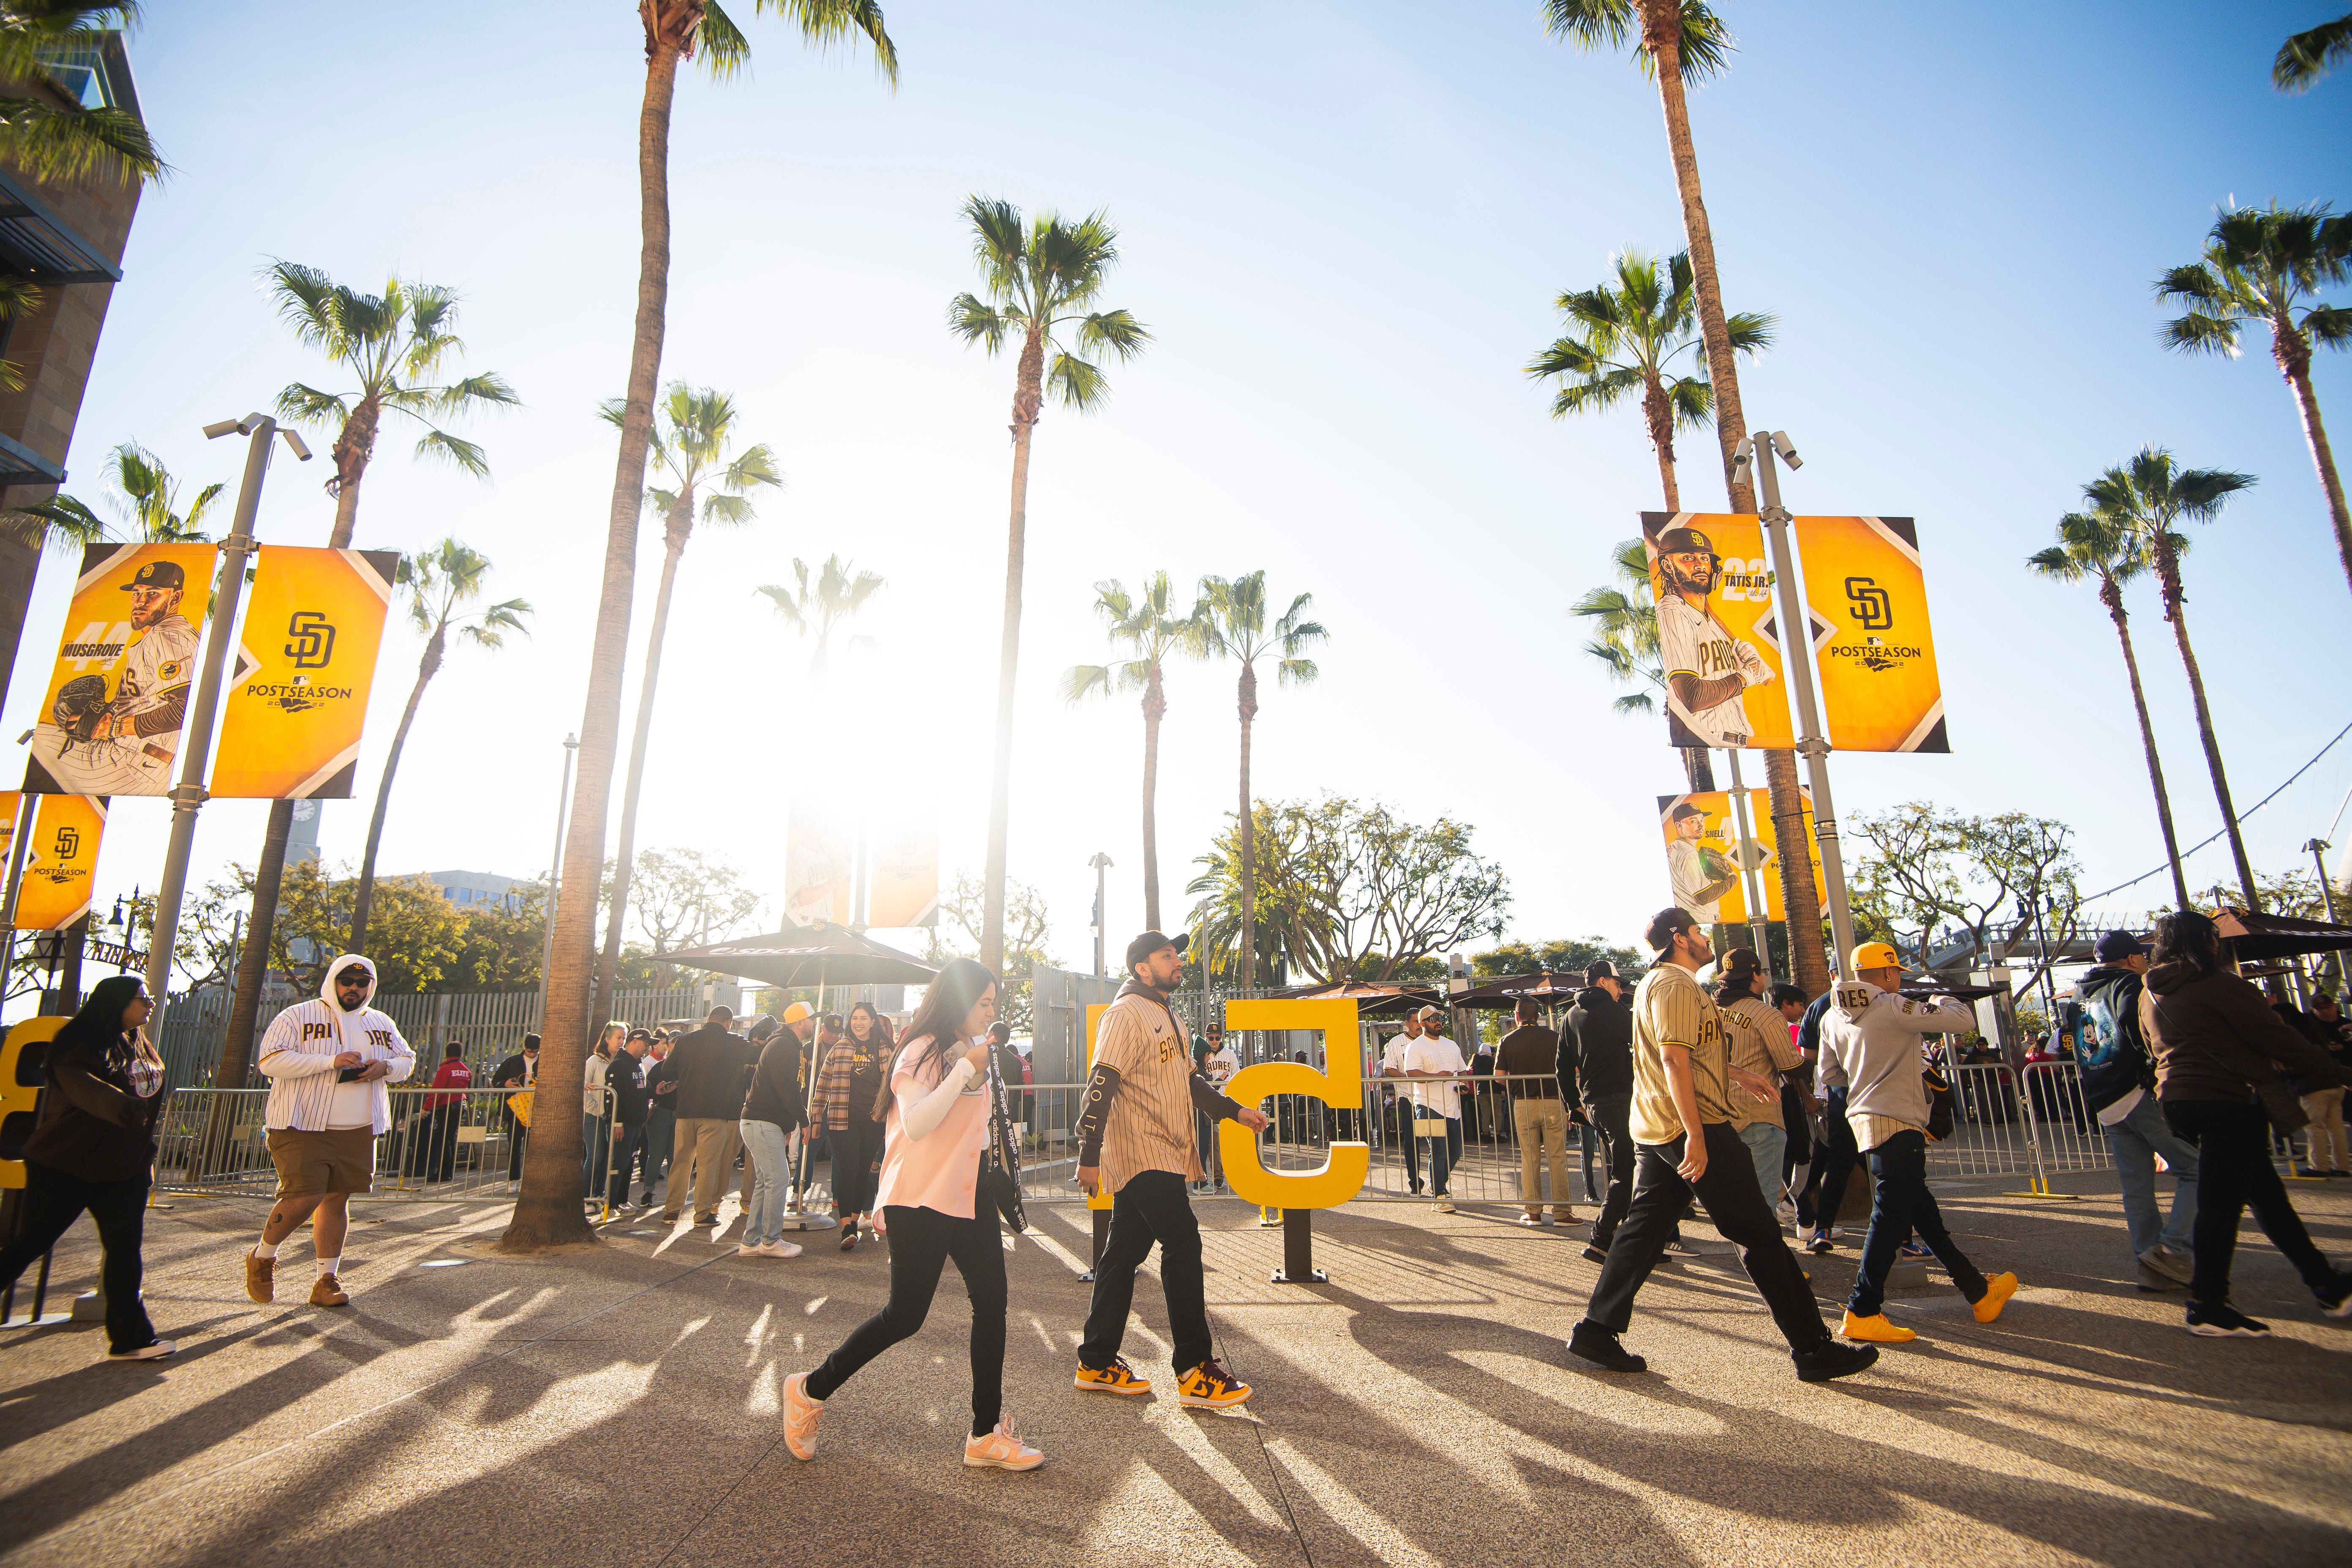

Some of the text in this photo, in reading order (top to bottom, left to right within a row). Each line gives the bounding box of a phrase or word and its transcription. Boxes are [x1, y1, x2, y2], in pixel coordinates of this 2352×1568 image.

[1722, 557, 1769, 602] 23
[1725, 575, 1768, 588] TATIS JR.
[1845, 577, 1892, 629] SD
[285, 612, 336, 668] SD
[61, 644, 125, 656] MUSGROVE
[1831, 646, 1921, 658] POSTSEASON
[247, 685, 352, 699] POSTSEASON
[54, 827, 79, 859] SD
[879, 865, 929, 873] POSTSEASON
[731, 946, 830, 955] SDCCU
[1314, 991, 1384, 999] SDCCU
[1719, 1009, 1752, 1030] HADO
[1207, 1061, 1230, 1072] ADRES
[1090, 1075, 1106, 1102] DO
[999, 1091, 1009, 1115] adidas
[1008, 1128, 1018, 1154] adidas
